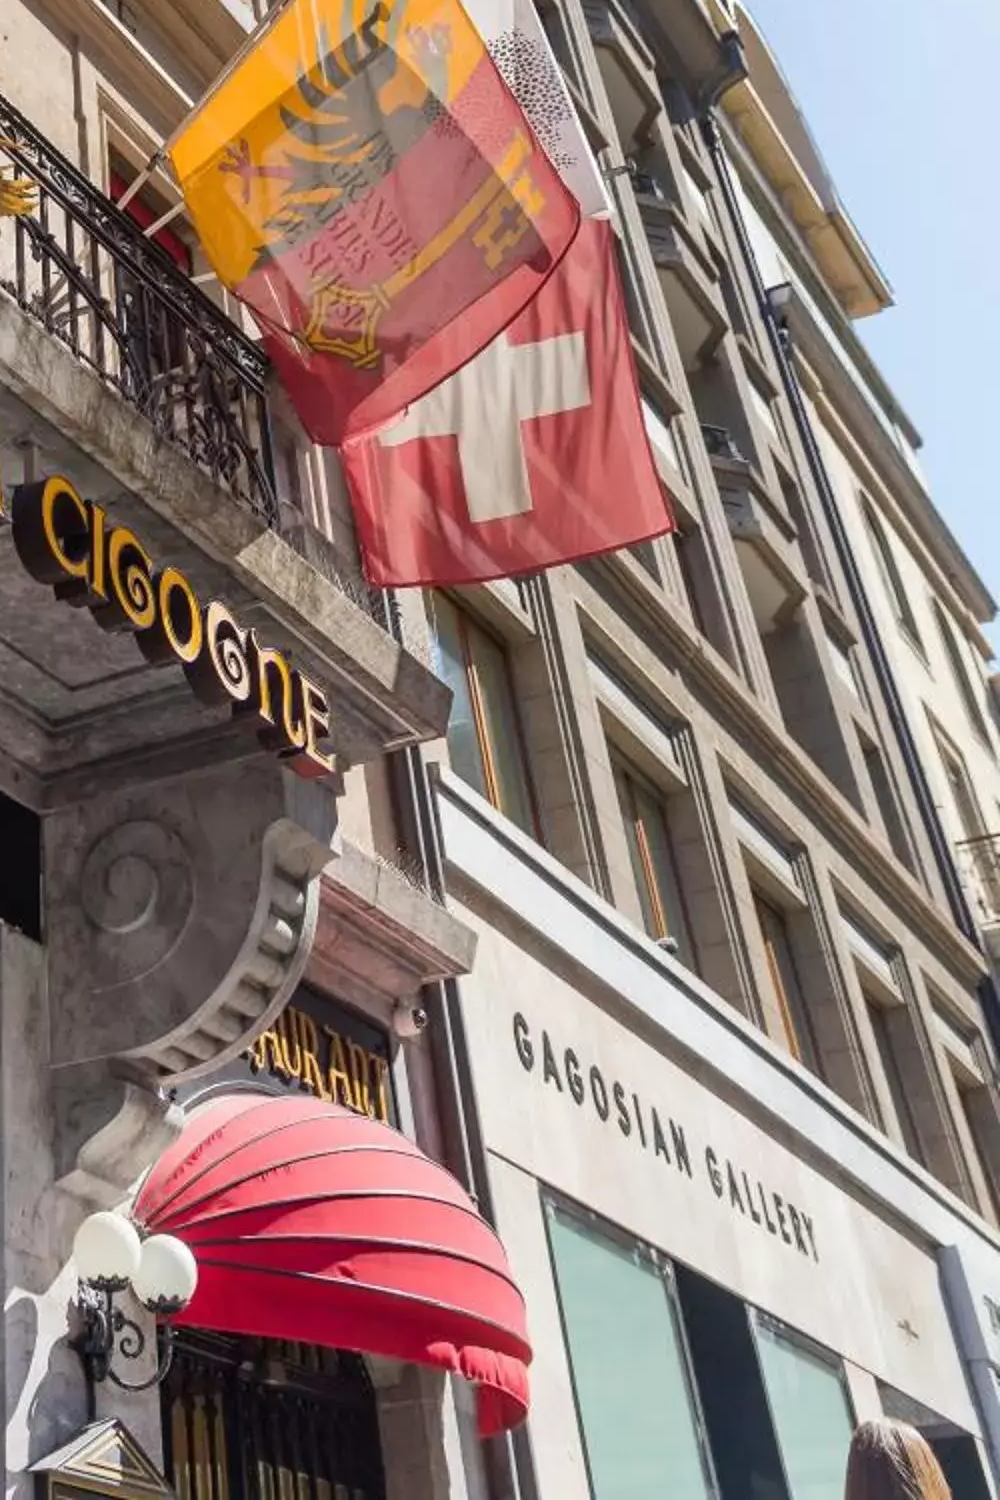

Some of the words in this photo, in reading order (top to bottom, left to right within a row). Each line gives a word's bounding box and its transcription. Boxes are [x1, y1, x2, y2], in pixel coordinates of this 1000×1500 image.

[303, 182, 377, 274] ABLES
[41, 474, 337, 774] CIGOGNE
[512, 1011, 693, 1180] GAGOSIAN
[705, 1146, 820, 1264] GALLERY
